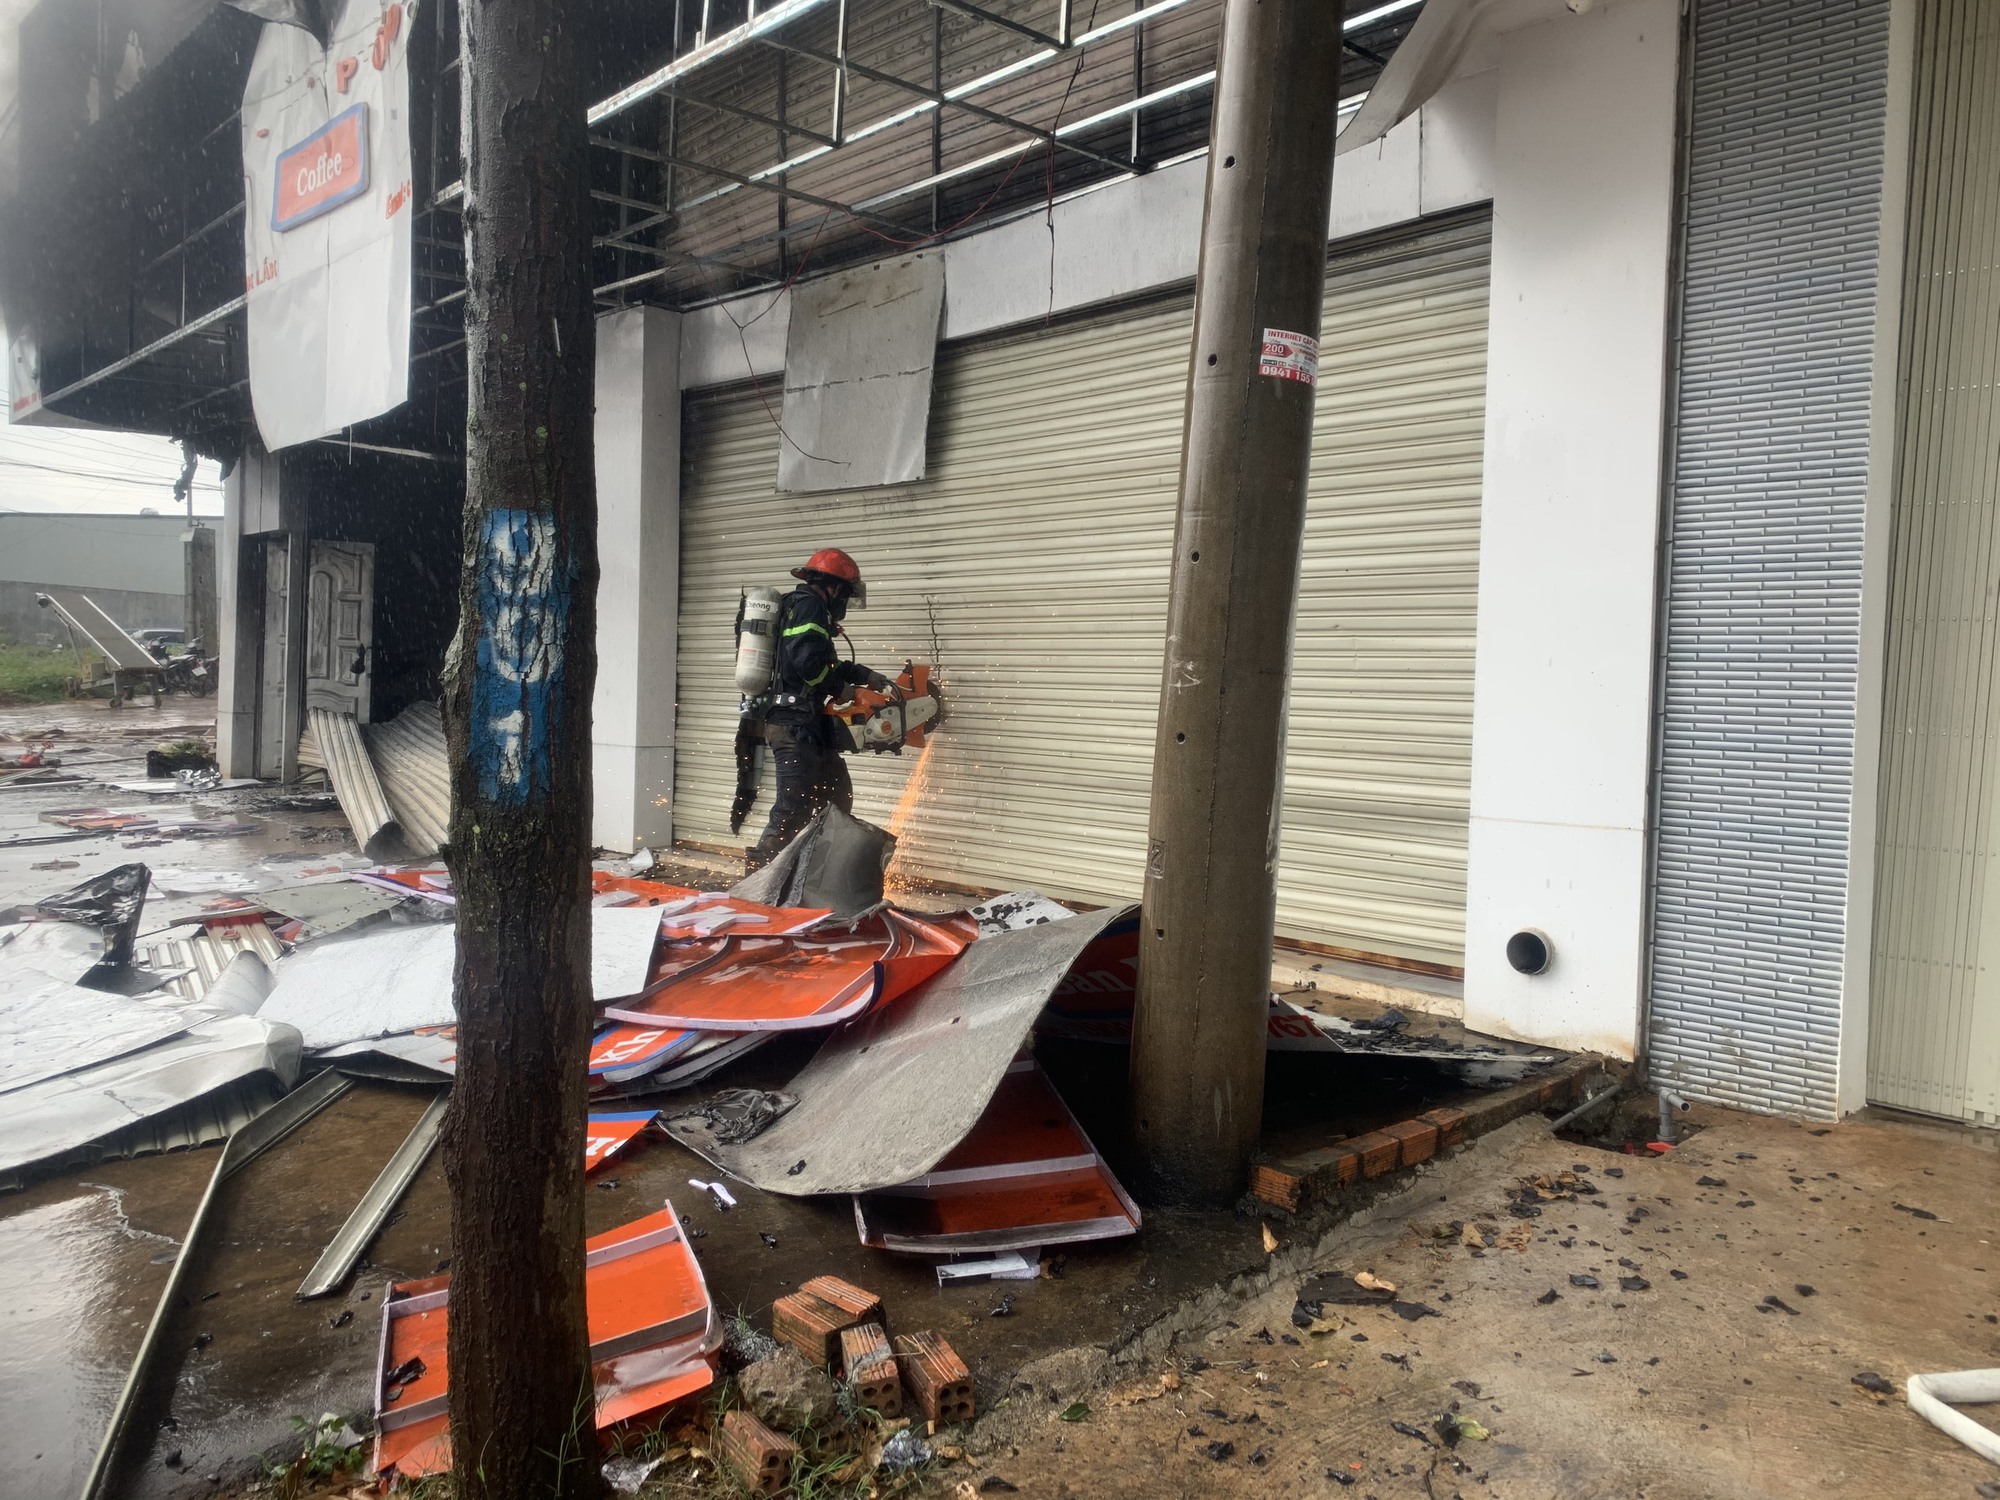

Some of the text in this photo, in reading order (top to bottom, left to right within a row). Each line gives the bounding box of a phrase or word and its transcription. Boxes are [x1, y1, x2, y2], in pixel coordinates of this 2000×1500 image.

[296, 152, 342, 197] Coffee
[1267, 330, 1302, 342] INTERNET
[1265, 343, 1284, 354] 200
[1262, 365, 1291, 378] 0941
